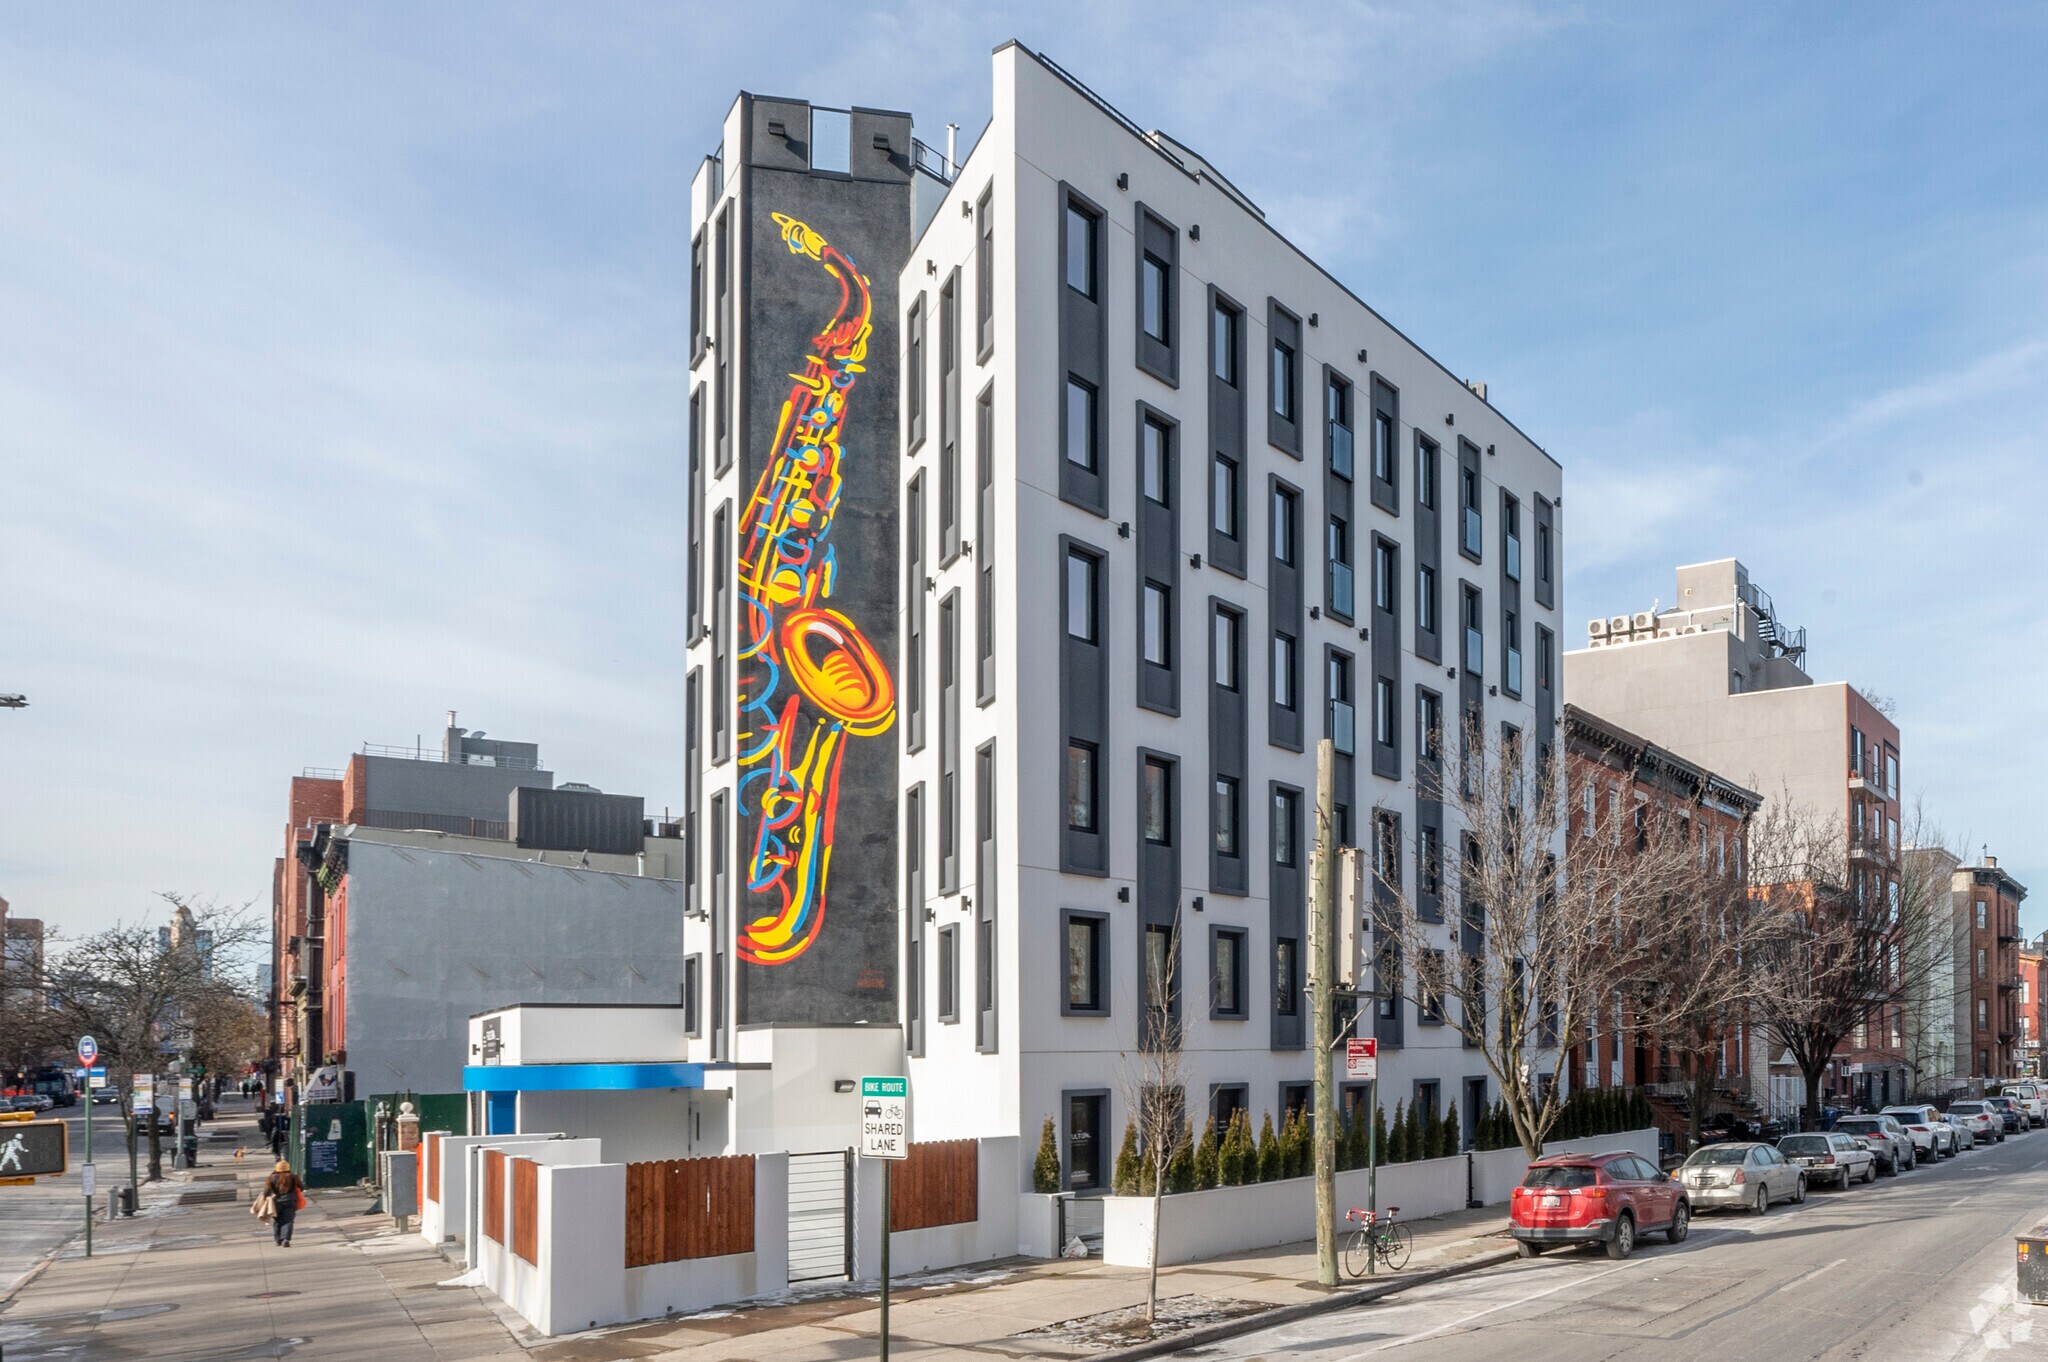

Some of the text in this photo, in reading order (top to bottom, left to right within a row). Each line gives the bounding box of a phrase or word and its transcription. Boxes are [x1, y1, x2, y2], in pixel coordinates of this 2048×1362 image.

[173, 1030, 190, 1039] 25
[865, 1082, 903, 1092] BIKE ROUTE
[865, 1123, 903, 1135] SHARED
[871, 1139, 896, 1151] LANE
